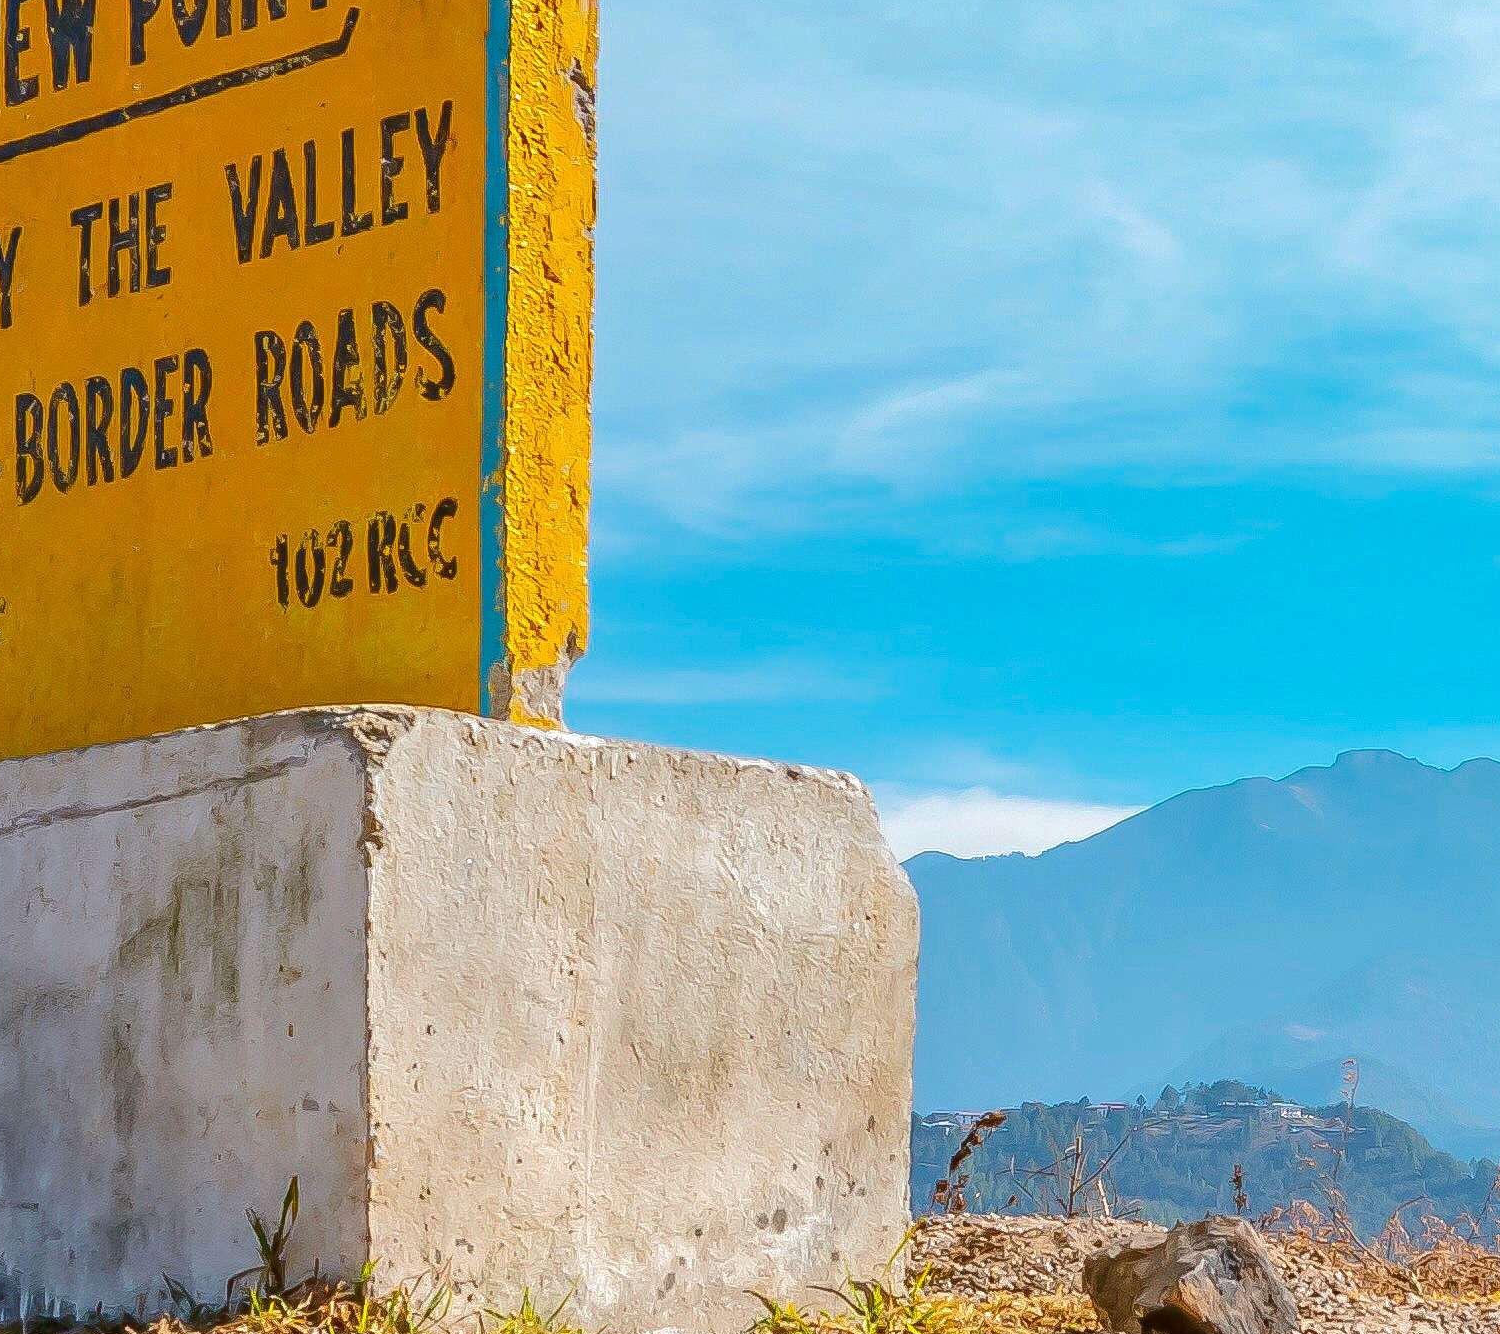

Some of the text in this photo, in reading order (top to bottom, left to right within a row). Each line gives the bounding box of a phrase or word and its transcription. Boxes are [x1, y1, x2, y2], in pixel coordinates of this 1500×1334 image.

[70, 182, 173, 307] THE
[225, 100, 453, 264] VALLEY
[15, 347, 214, 506] BORDER
[255, 288, 456, 446] ROADS
